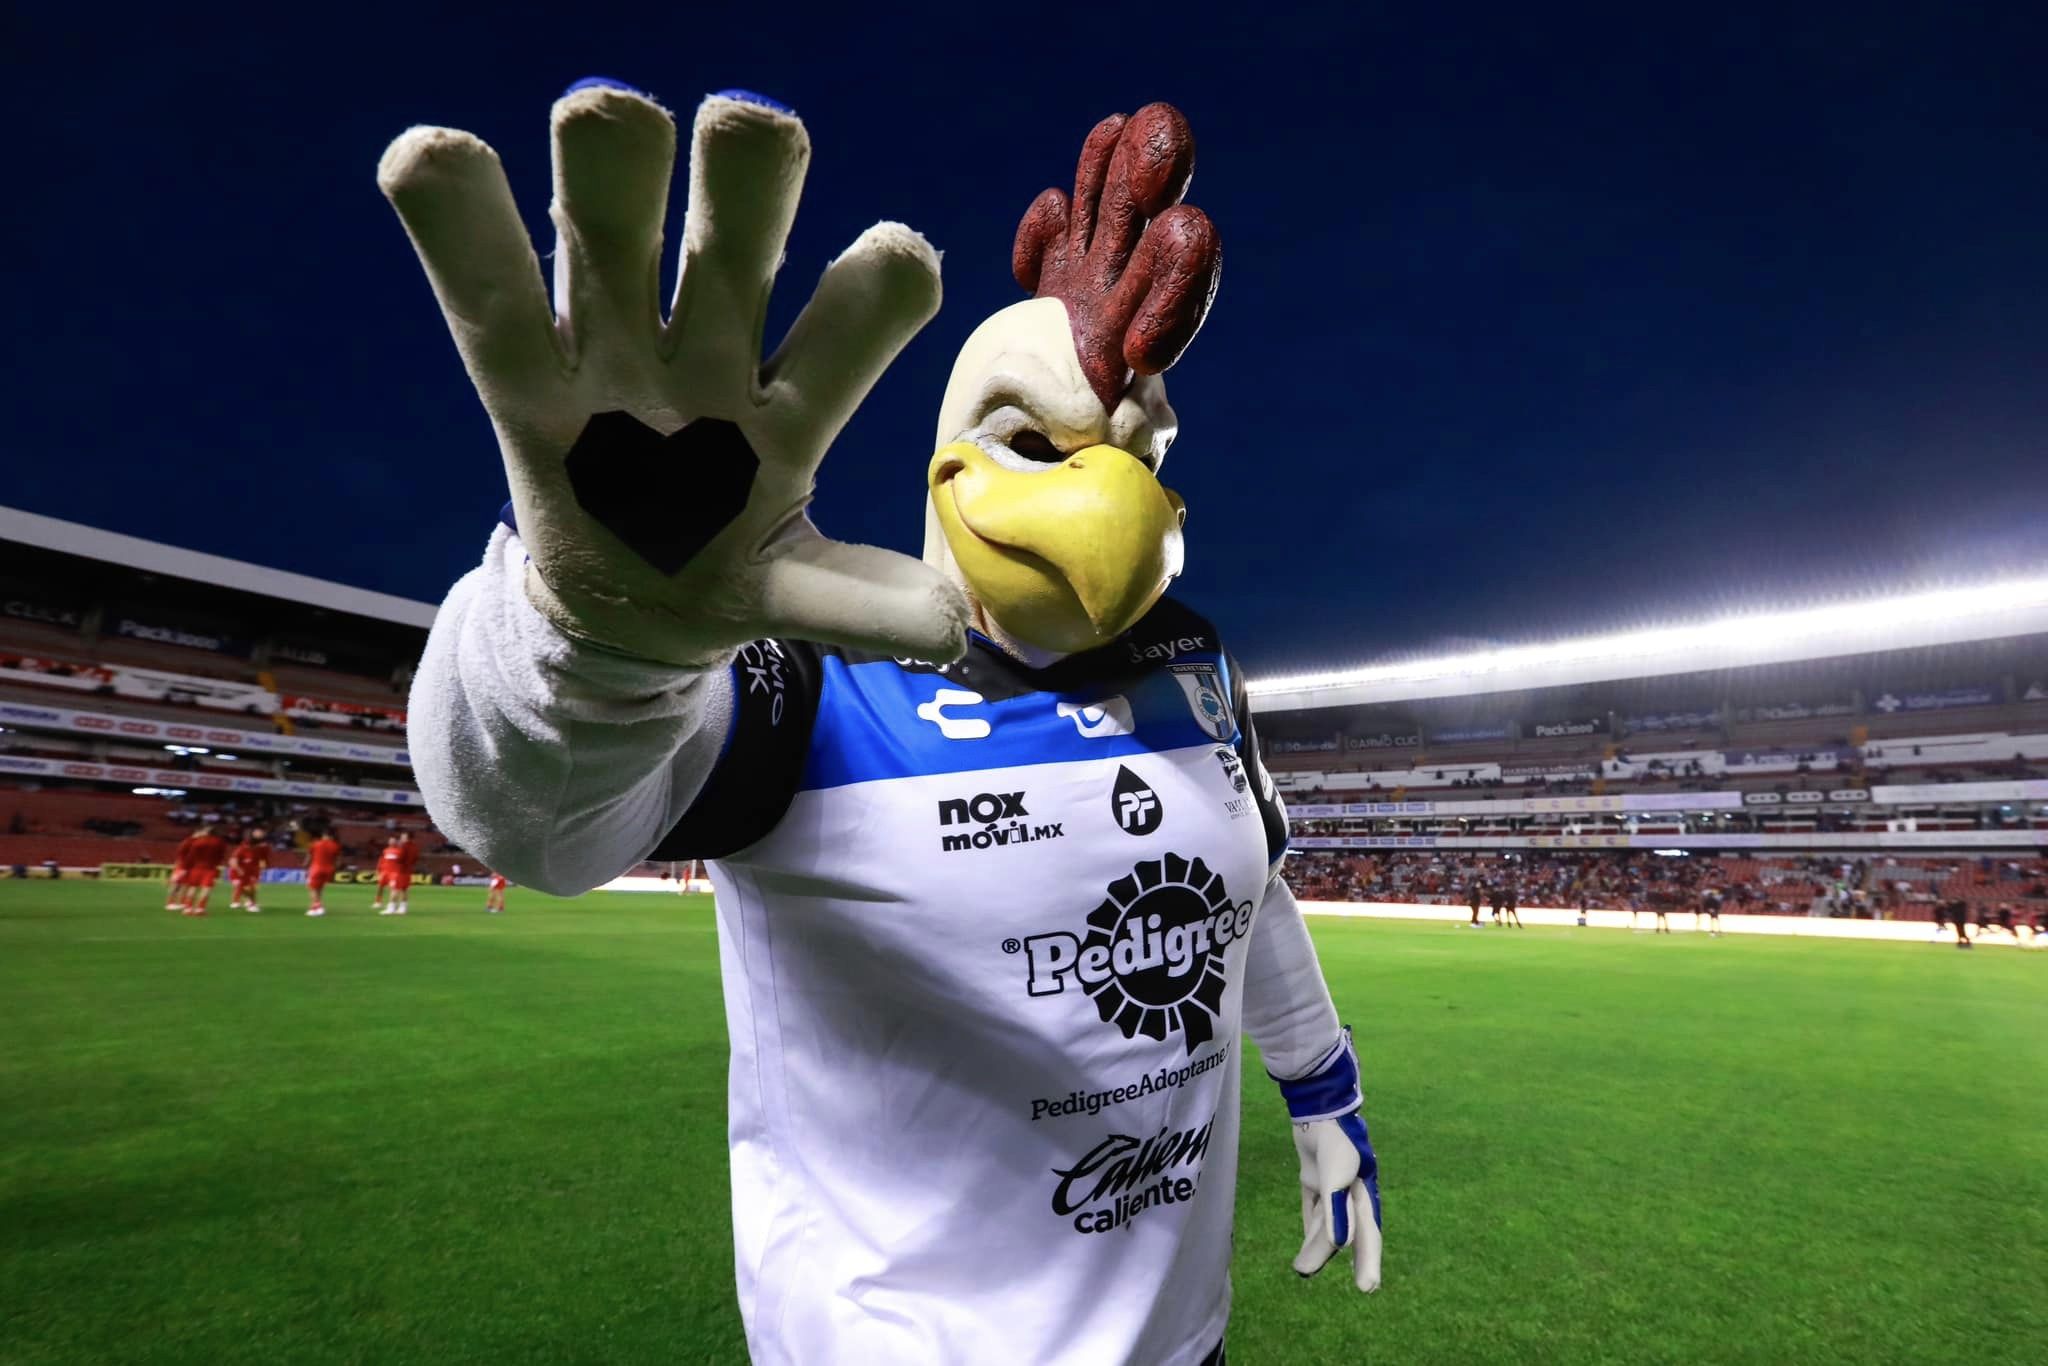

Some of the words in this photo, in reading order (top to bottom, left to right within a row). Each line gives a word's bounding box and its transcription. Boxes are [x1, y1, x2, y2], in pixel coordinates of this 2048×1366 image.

[938, 791, 1029, 825] nox
[1119, 790, 1155, 828] PF
[1024, 900, 1253, 997] Pedigree
[1031, 1040, 1231, 1120] PedigreeAdoptame
